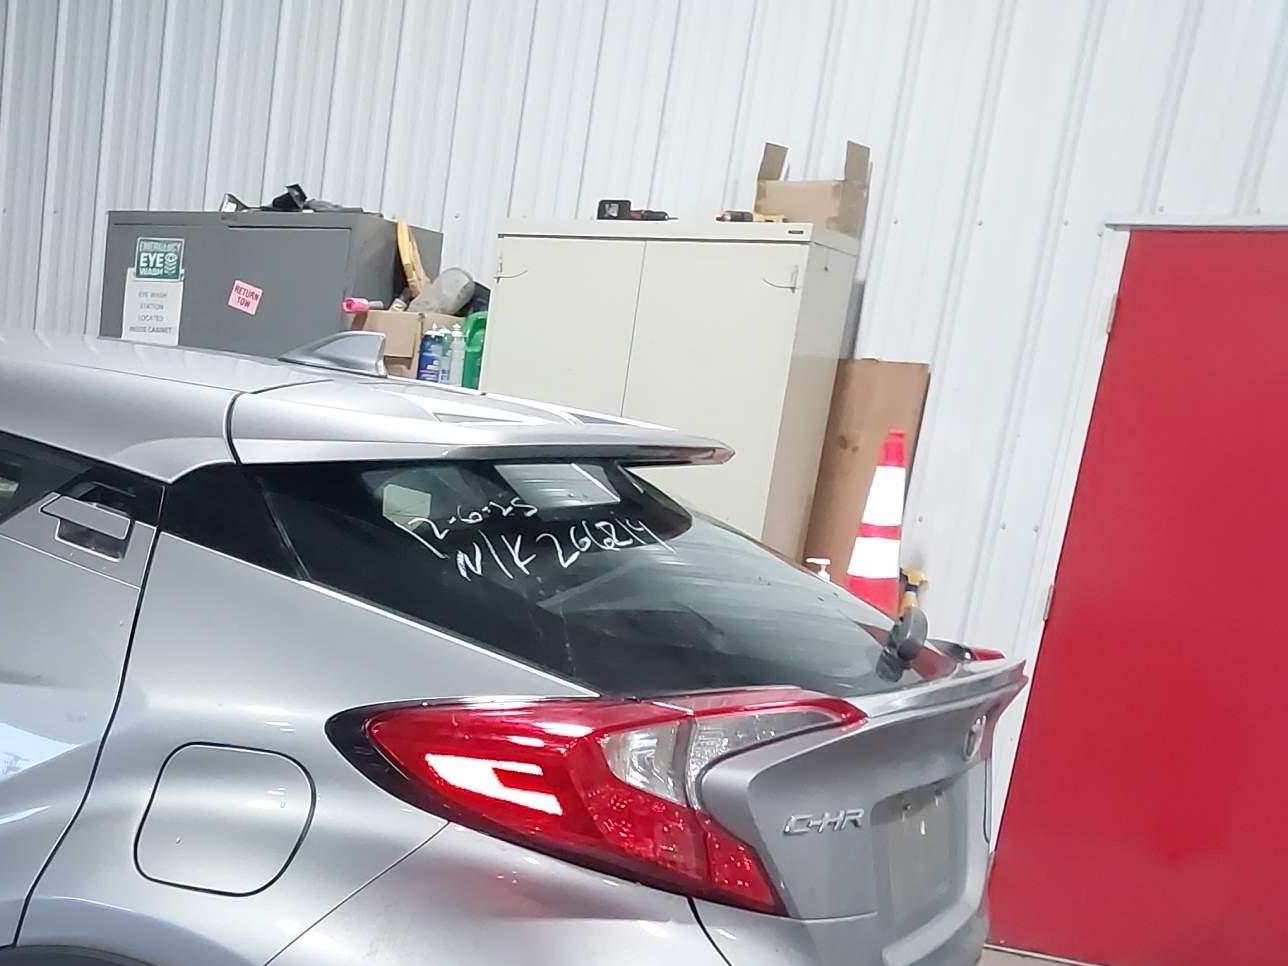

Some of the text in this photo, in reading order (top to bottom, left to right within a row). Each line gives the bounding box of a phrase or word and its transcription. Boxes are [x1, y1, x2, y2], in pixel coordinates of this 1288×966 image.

[139, 252, 165, 267] EYE
[234, 285, 259, 301] RETURN
[237, 295, 251, 308] TOW
[784, 808, 866, 835] C-HR
